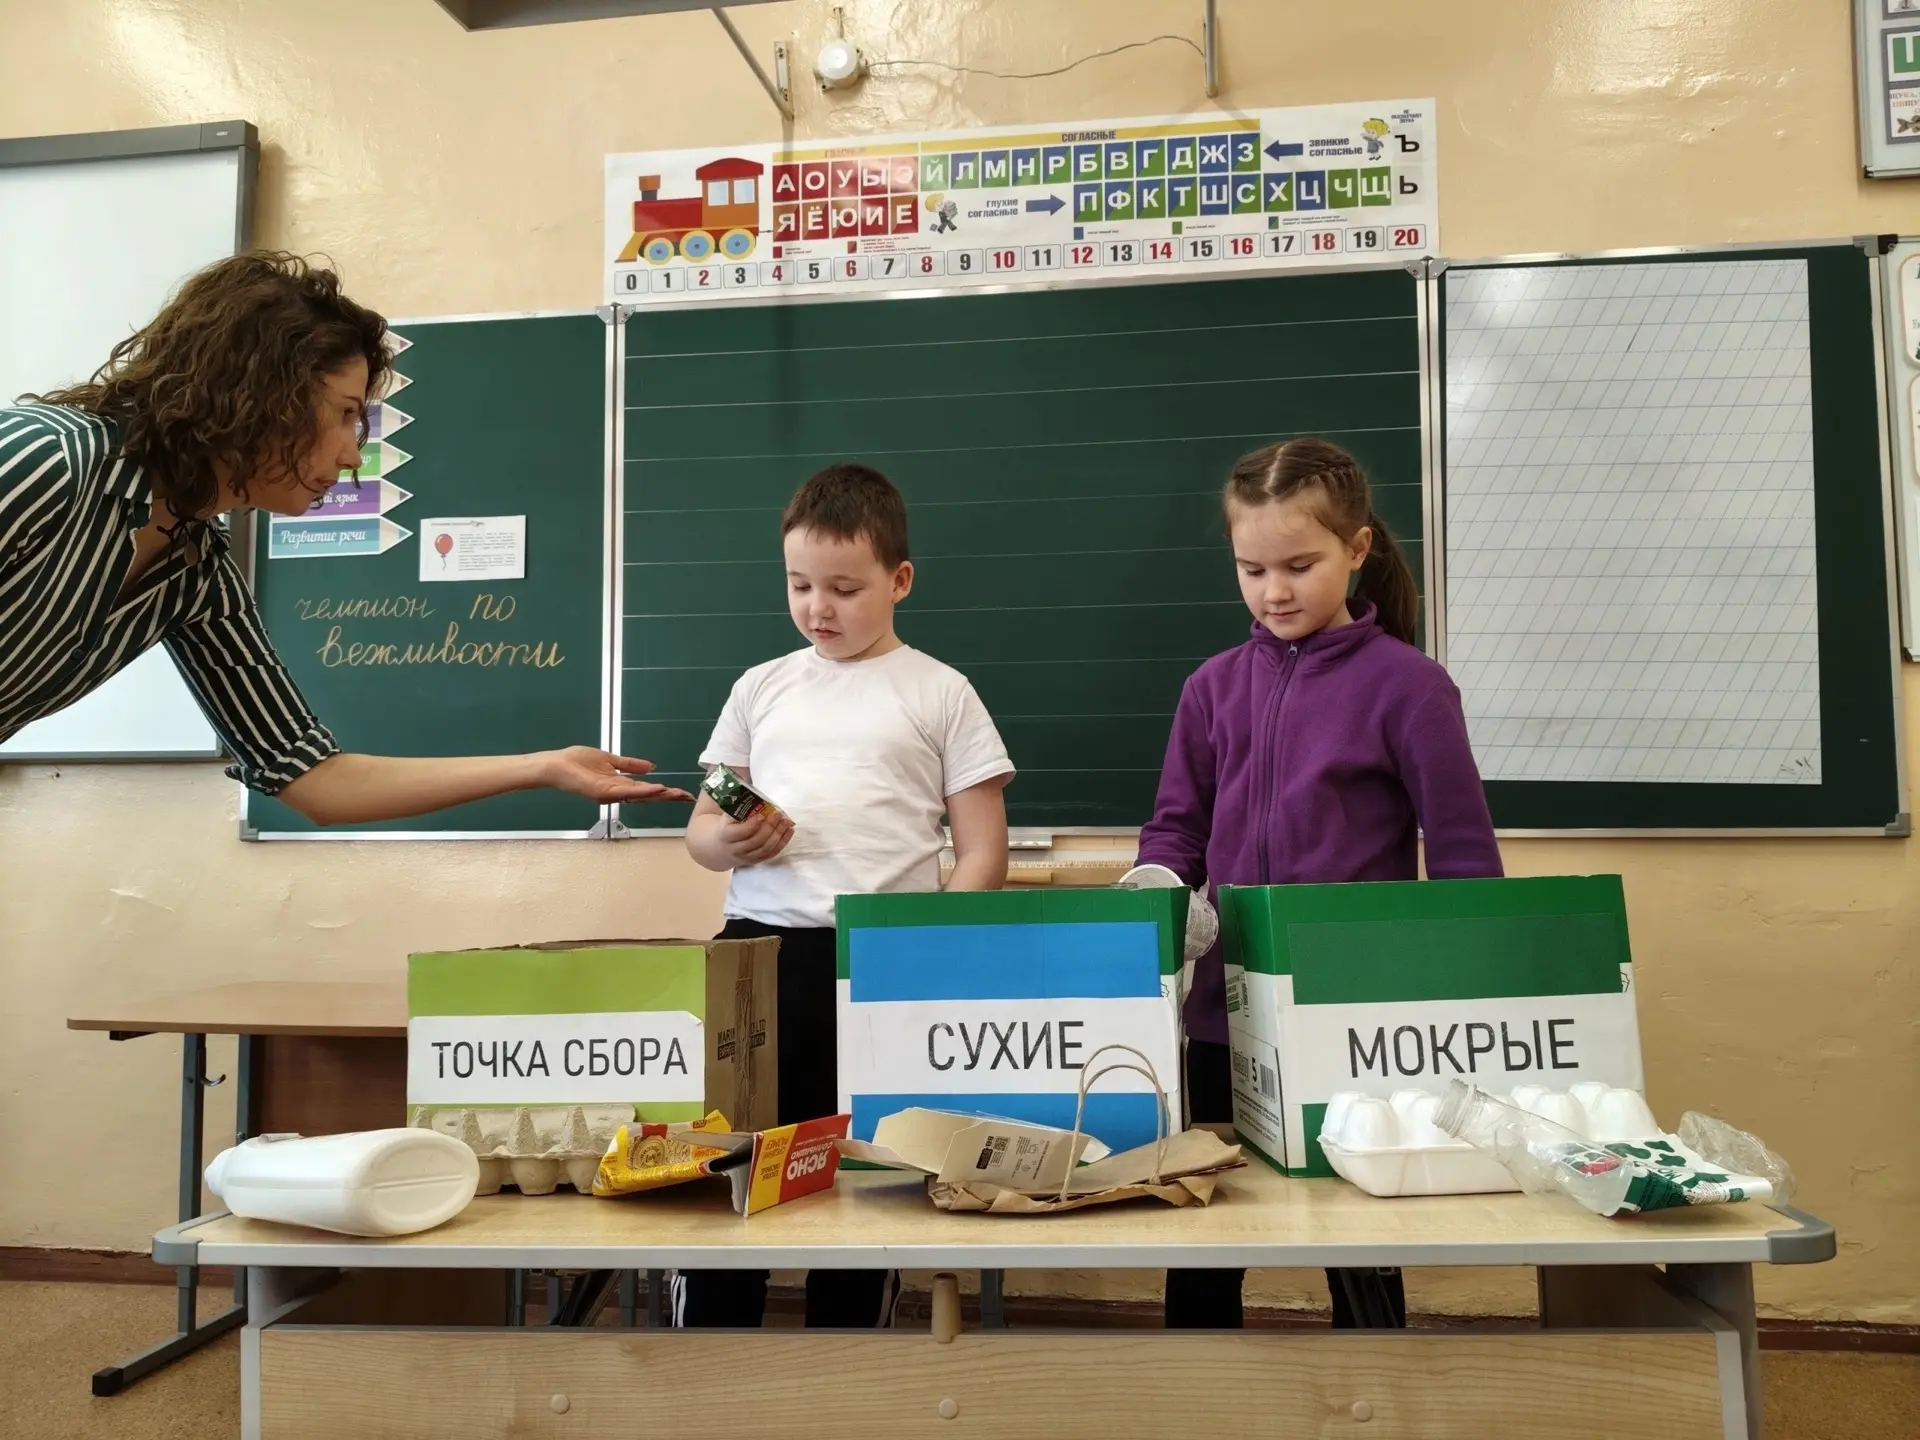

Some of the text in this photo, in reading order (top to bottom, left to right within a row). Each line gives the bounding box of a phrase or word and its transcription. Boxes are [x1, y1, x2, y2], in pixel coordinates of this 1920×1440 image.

[1061, 129, 1117, 143] СОГЛАСНЫЕ
[1394, 134, 1420, 153] Ъ
[776, 174, 796, 193] А
[805, 171, 825, 190] О
[836, 169, 854, 188] У
[861, 167, 887, 186] Ы
[925, 159, 944, 181] Й
[955, 160, 974, 180] Л
[984, 159, 1007, 179] М
[1017, 157, 1035, 176] Н
[1048, 155, 1065, 175] Р
[1079, 154, 1097, 173] Б
[1110, 152, 1128, 171] В
[1143, 149, 1157, 168] Г
[1172, 147, 1193, 169] Д
[1201, 145, 1227, 164] Ж
[1237, 143, 1255, 163] З
[1079, 176, 1391, 212] П Ф К Т Ш С Х Ц Ч Щ
[776, 204, 913, 232] Я Ё Ю И Е
[626, 229, 1419, 290] 0 1 2 3 4 5 6 7 8 9 10 11 12 13 14 15 16 17 18 19 20
[335, 493, 358, 508] язык
[281, 530, 366, 549] Развитие речи
[470, 593, 516, 621] по
[317, 622, 565, 669] вежливости
[431, 1041, 550, 1078] ТОЧКА
[564, 1037, 688, 1077] СБОРА
[928, 1020, 1086, 1071] СУХИЕ
[1348, 1018, 1579, 1078] МОКРЫЕ
[786, 1150, 829, 1180] ЯСНО
